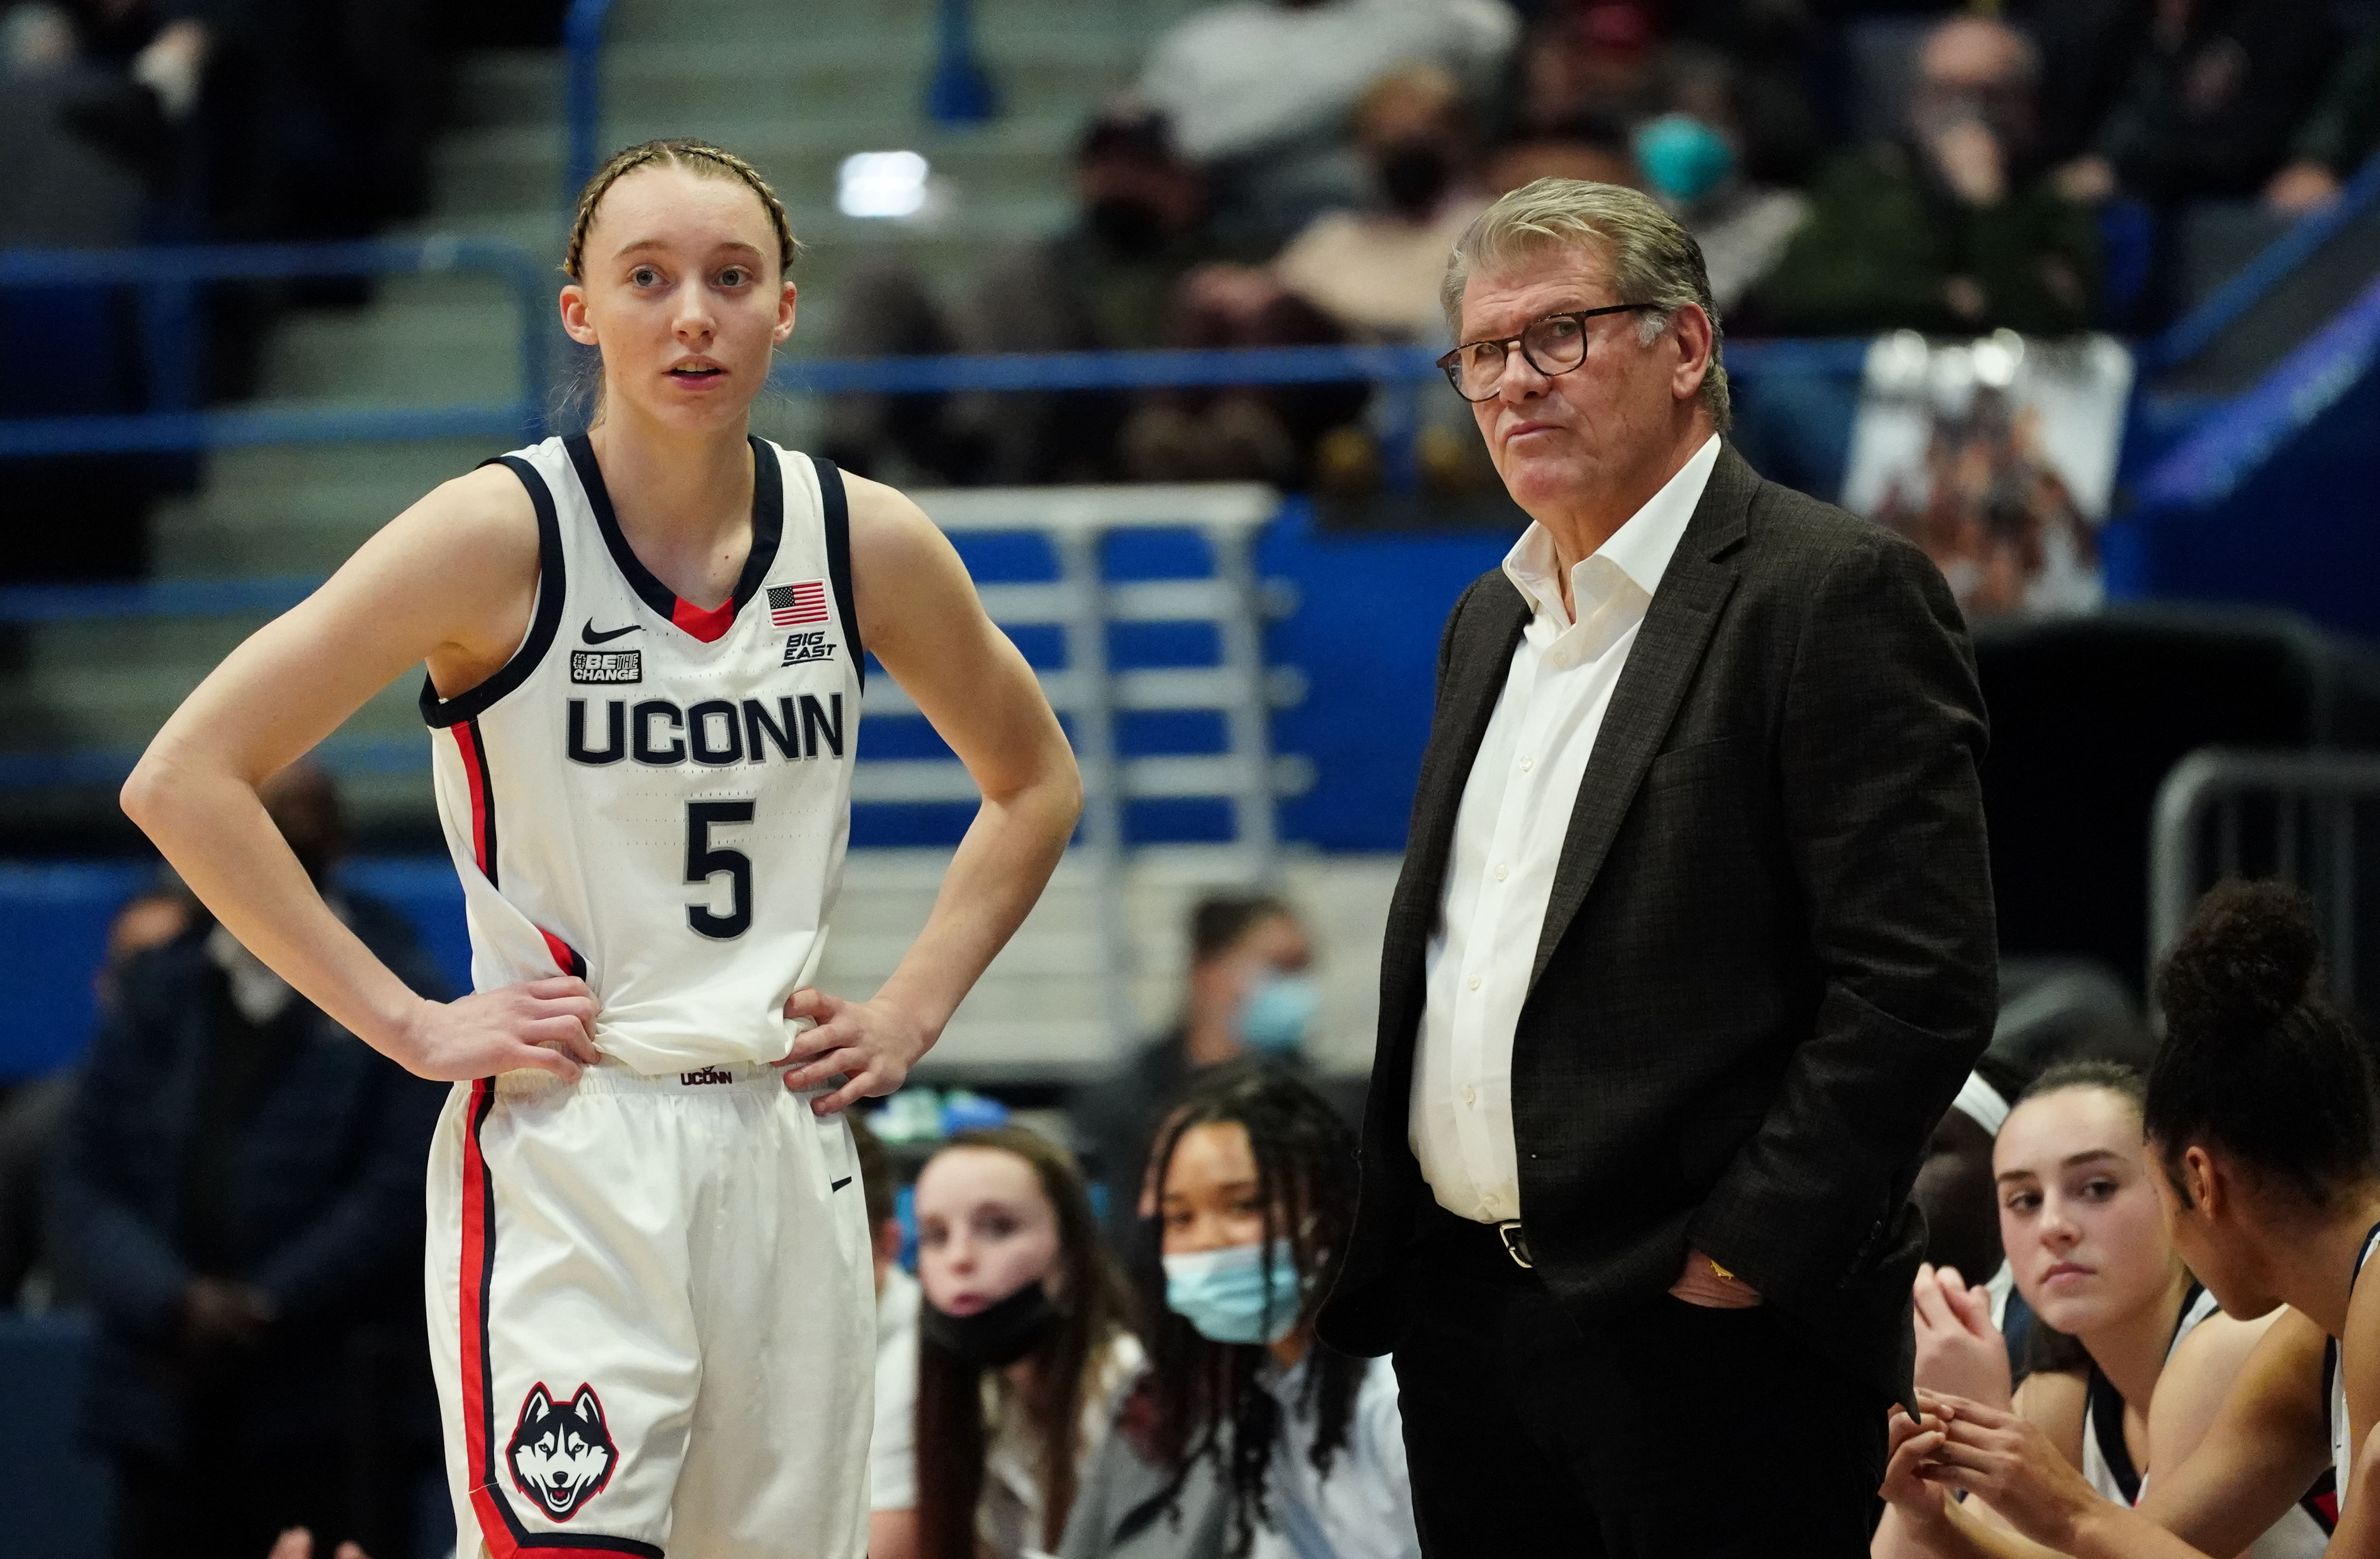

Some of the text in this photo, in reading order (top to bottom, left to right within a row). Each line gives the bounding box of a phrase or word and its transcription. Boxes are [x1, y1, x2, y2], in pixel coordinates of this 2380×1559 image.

[786, 631, 825, 648] BIG
[784, 644, 837, 660] EAST
[574, 669, 639, 681] CHANGE
[566, 692, 844, 767] UCONN
[683, 798, 756, 942] 5
[681, 1071, 732, 1086] UCONN
